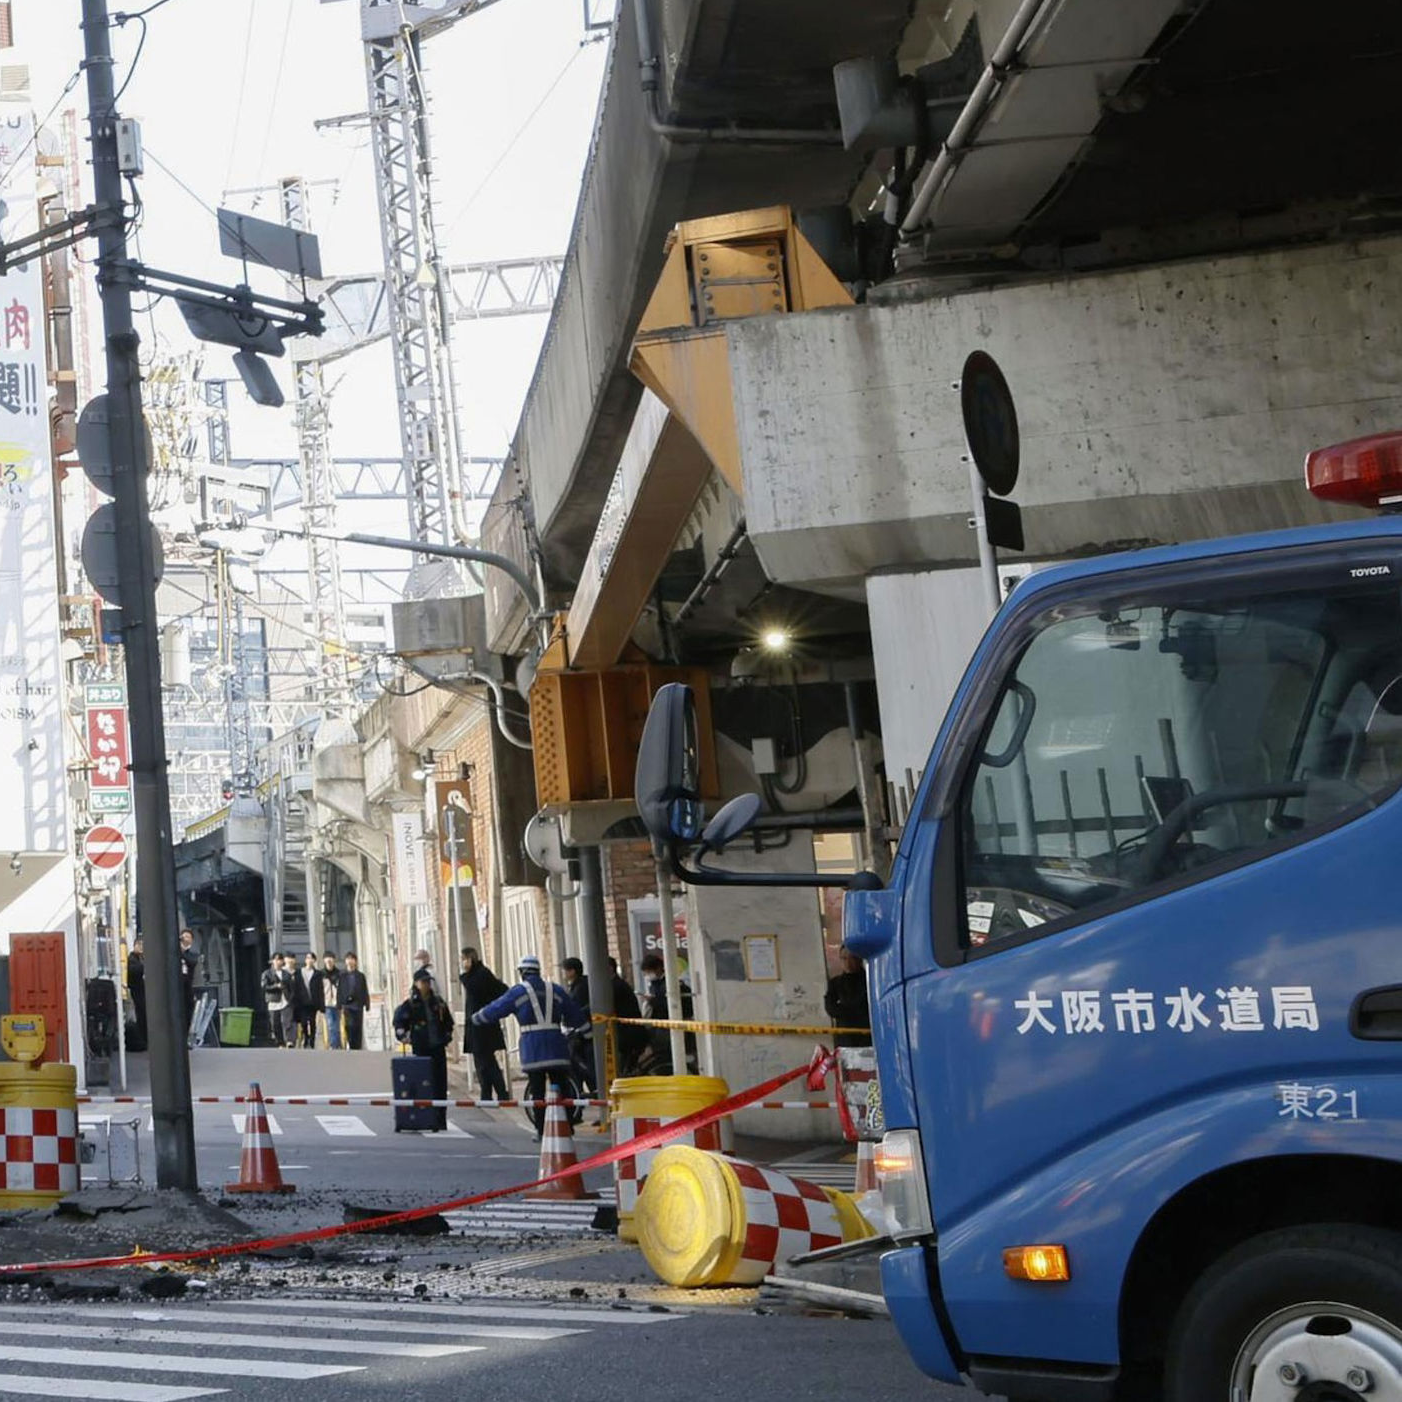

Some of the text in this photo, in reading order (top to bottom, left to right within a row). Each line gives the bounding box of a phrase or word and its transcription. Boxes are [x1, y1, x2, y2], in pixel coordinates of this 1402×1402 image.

[1349, 565, 1391, 578] TOYOTA
[6, 678, 21, 696] of
[24, 678, 53, 696] hair
[403, 821, 416, 858] INOVE
[645, 933, 690, 950] Seia
[1014, 985, 1321, 1035] 大阪市水道局
[1278, 1082, 1358, 1119] 東21
